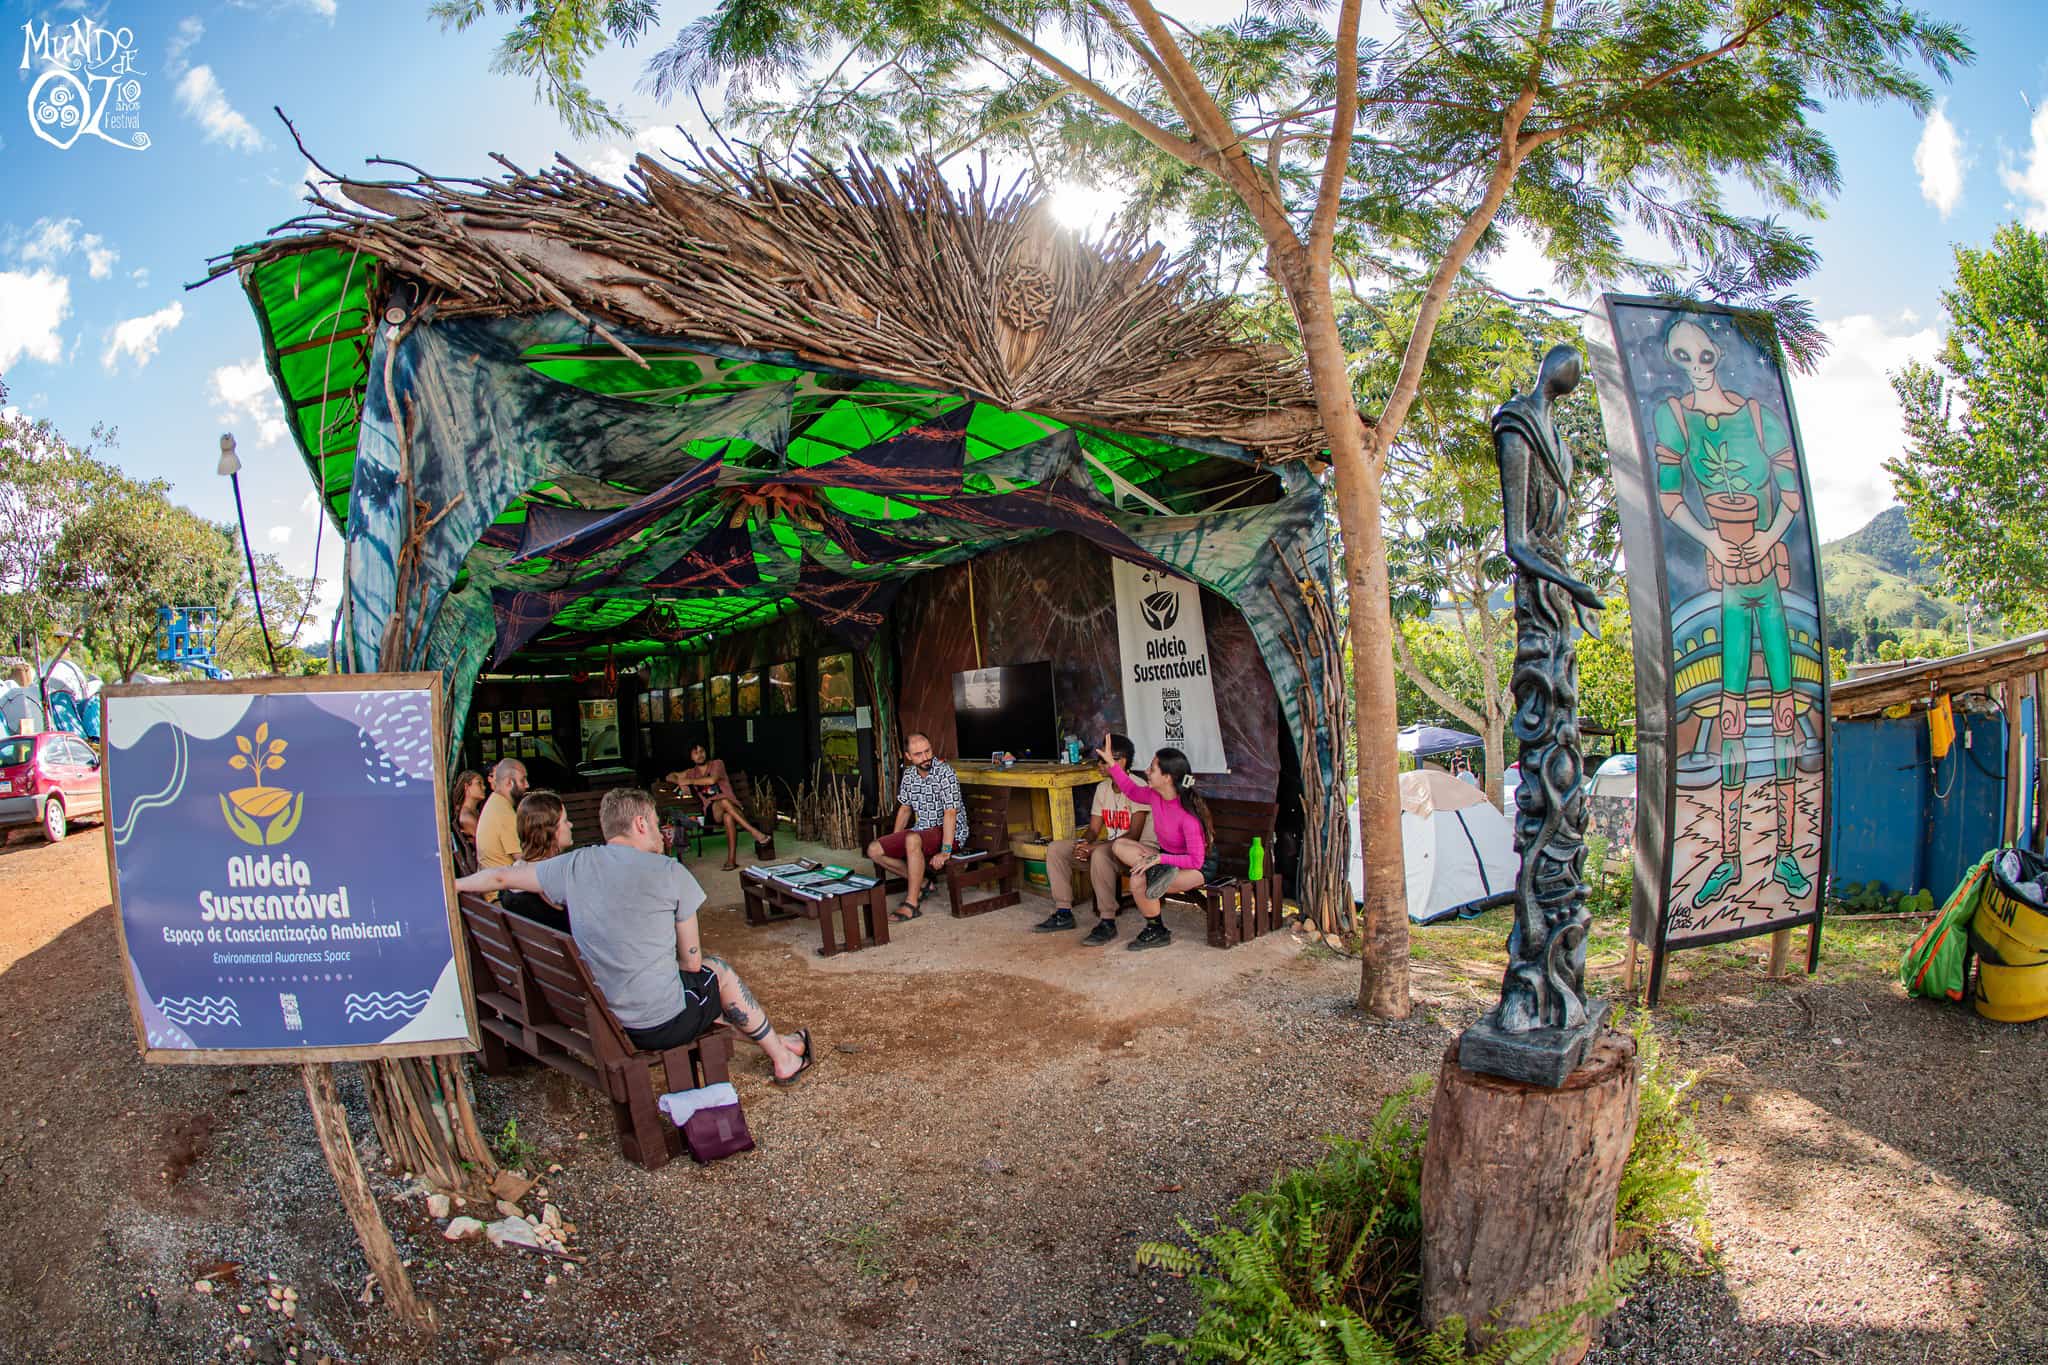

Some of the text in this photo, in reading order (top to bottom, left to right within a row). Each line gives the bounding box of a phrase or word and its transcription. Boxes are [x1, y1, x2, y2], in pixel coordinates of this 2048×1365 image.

[1146, 636, 1187, 661] Aldeia
[1134, 654, 1207, 683] Sustentável
[227, 853, 312, 887] Aldeia
[199, 886, 351, 921] Sustentável
[162, 921, 402, 946] Espaço de Conscientização Ambiental
[213, 950, 351, 964] Environmental Awareness Space
